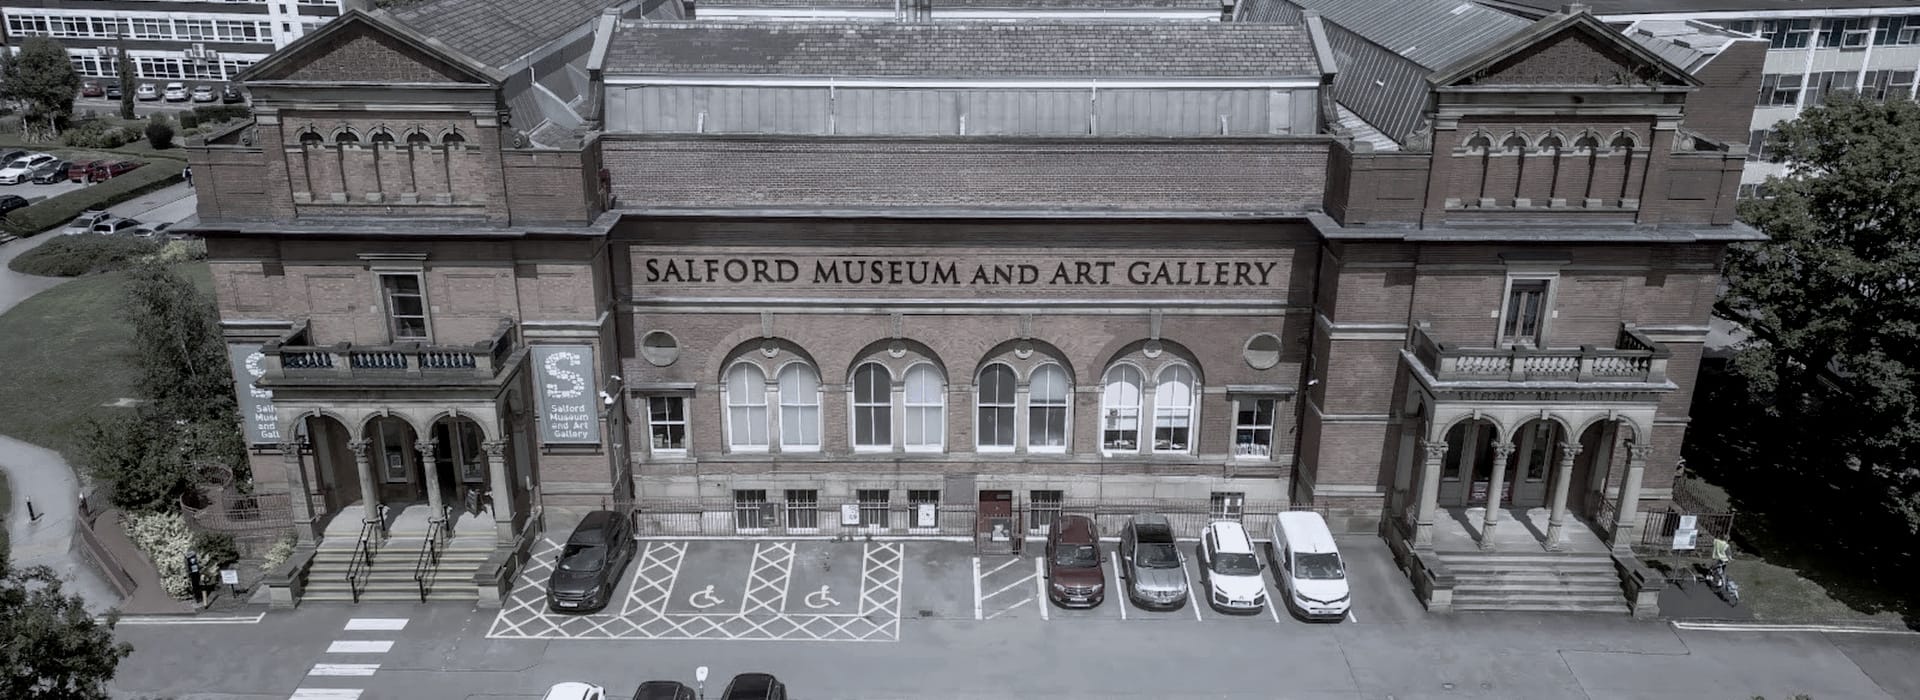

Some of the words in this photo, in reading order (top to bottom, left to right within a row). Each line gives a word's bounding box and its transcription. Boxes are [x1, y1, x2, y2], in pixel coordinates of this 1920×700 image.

[645, 258, 799, 283] SALFORD
[812, 259, 961, 285] MUSEUM
[970, 264, 1039, 285] AND
[1049, 261, 1116, 285] ART
[1127, 261, 1278, 286] GALLERY
[545, 351, 585, 398] S
[551, 404, 585, 413] Salford
[550, 413, 589, 421] Museum
[258, 422, 275, 430] and
[552, 422, 569, 430] and
[573, 422, 588, 430] Art
[554, 430, 588, 439] Gallery
